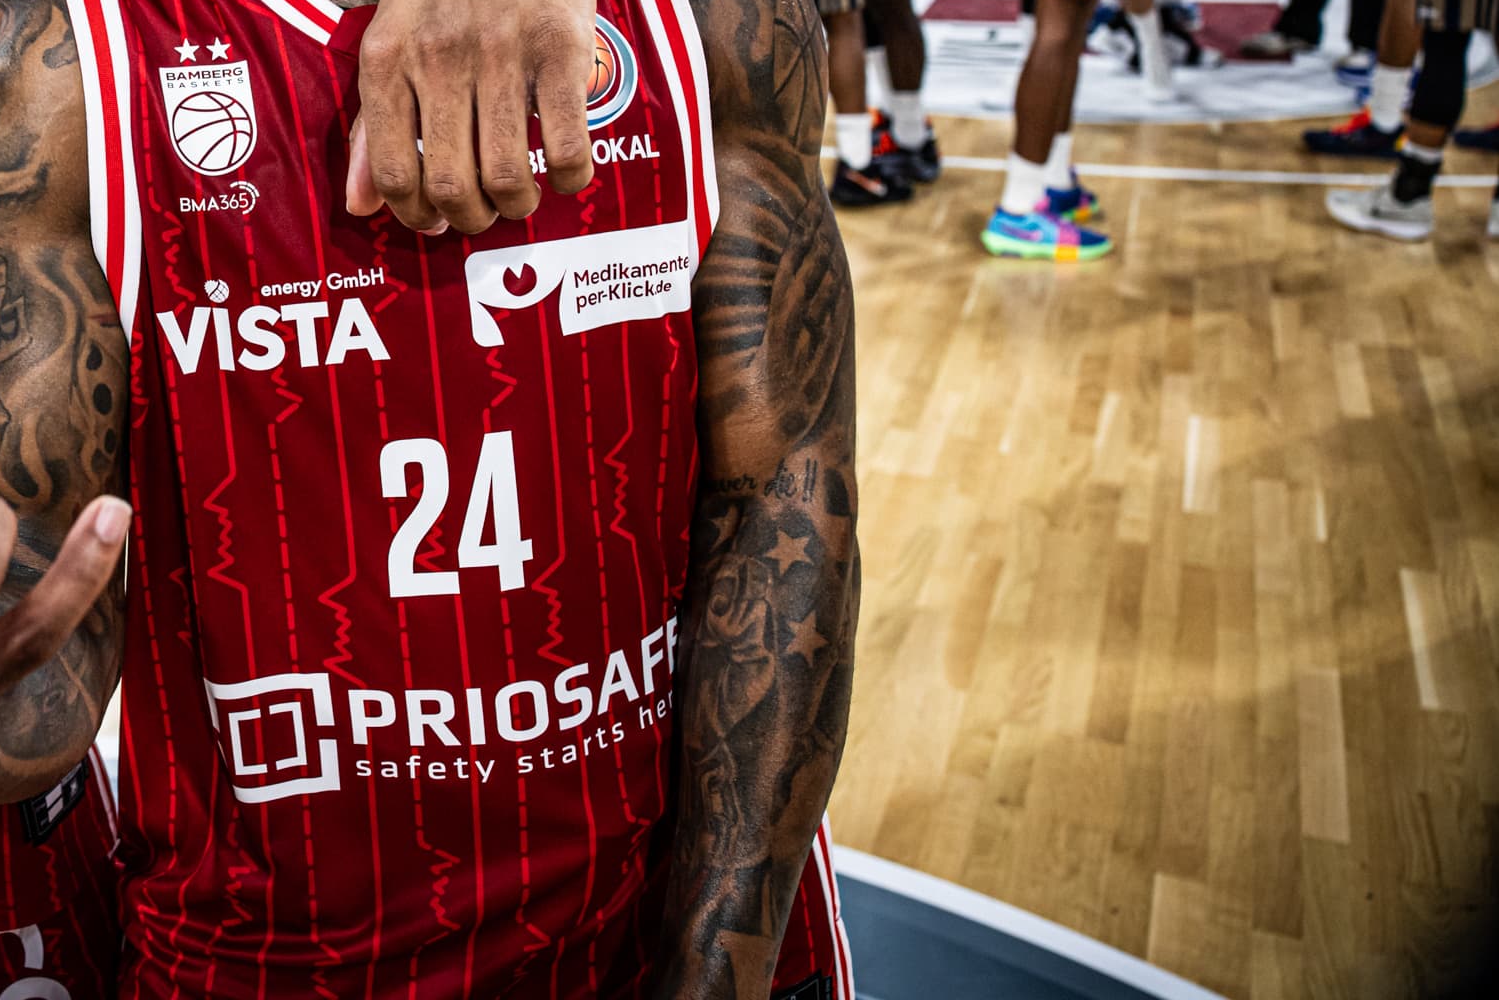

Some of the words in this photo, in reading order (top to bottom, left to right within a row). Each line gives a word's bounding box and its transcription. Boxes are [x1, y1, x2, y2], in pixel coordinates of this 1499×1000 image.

[166, 67, 243, 81] BAMBERG
[167, 77, 244, 89] BASKETS
[591, 133, 660, 166] OKAL
[179, 192, 249, 212] BMA365
[260, 277, 322, 300] energy
[326, 267, 385, 292] GmbH
[574, 255, 689, 289] Medikamente
[576, 280, 672, 314] per-Klick.de
[156, 297, 391, 376] VISTA
[379, 430, 533, 598] 24
[355, 754, 496, 784] safety
[517, 724, 625, 775] starts
[638, 690, 673, 730] her
